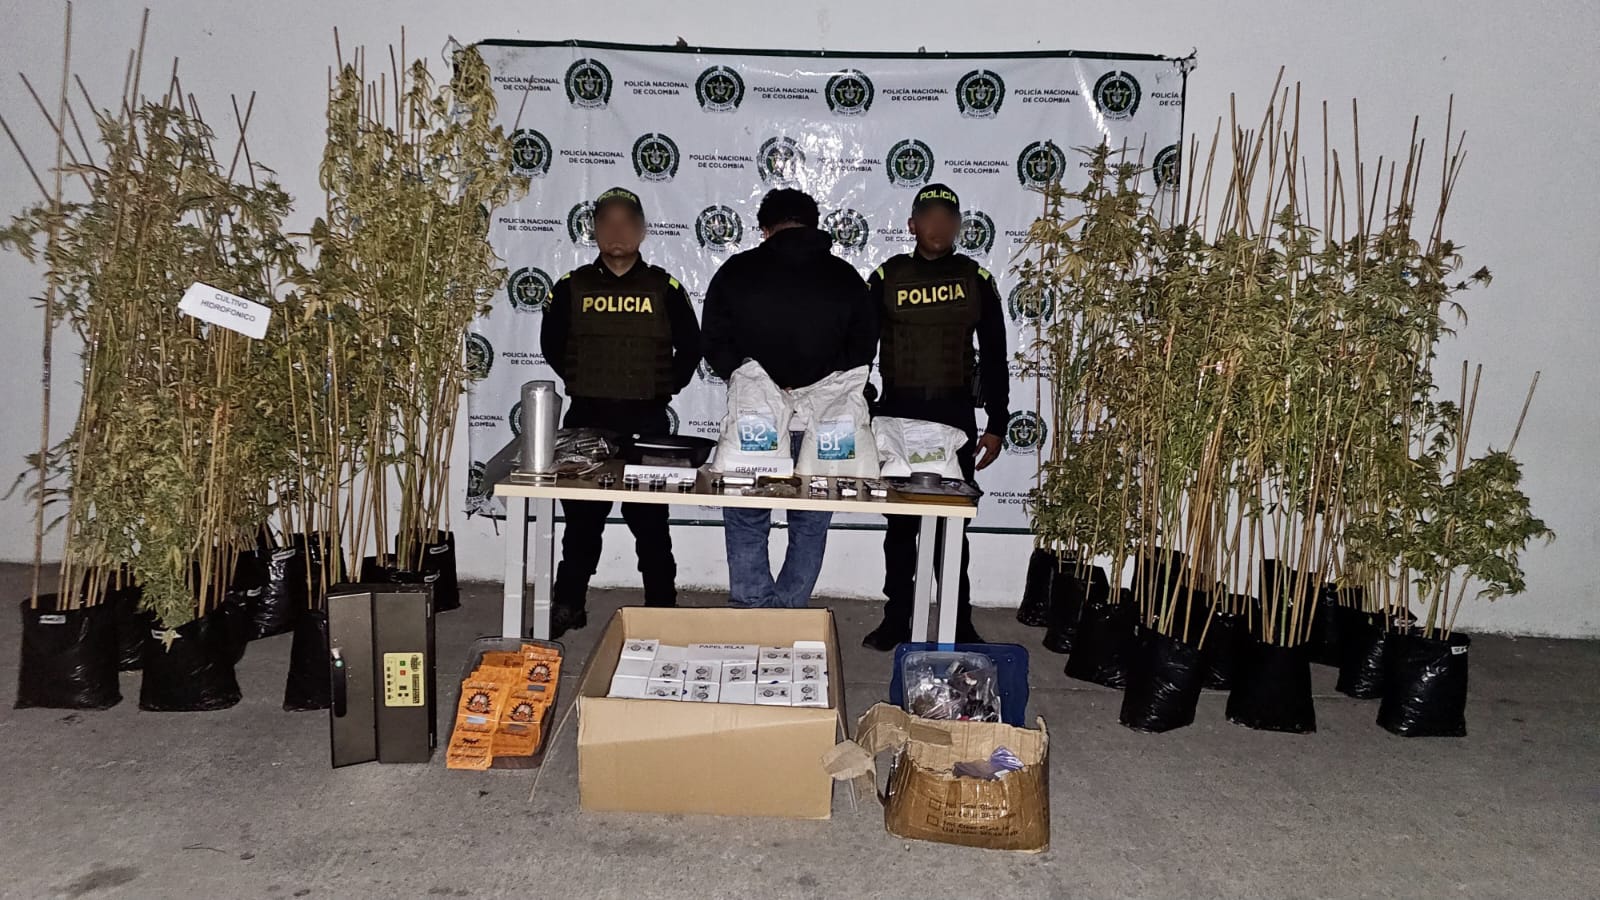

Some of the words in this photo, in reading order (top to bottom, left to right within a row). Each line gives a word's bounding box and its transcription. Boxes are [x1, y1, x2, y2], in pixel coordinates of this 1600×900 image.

[494, 75, 521, 84] POLICÍA
[523, 77, 560, 85] NACIONAL
[624, 79, 651, 87] POLICÍA
[653, 81, 689, 89] NACIONAL
[514, 84, 551, 92] COLOMBIA
[753, 84, 780, 93] POLICÍA
[882, 87, 910, 95] POLICÍA
[1014, 88, 1042, 96] POLICÍA
[1151, 90, 1179, 99] POLICÍA
[560, 149, 587, 157] POLICÍA
[689, 153, 716, 161] POLICÍA
[944, 159, 971, 167] POLICÍA
[920, 189, 957, 204] POLICIA
[653, 222, 690, 230] NACIONAL
[897, 282, 966, 306] POLICIA
[215, 293, 249, 310] CULTIVO
[582, 295, 653, 313] POLICIA
[741, 423, 768, 442] B2
[819, 432, 841, 451] B1
[735, 466, 778, 475] GRAMERAS
